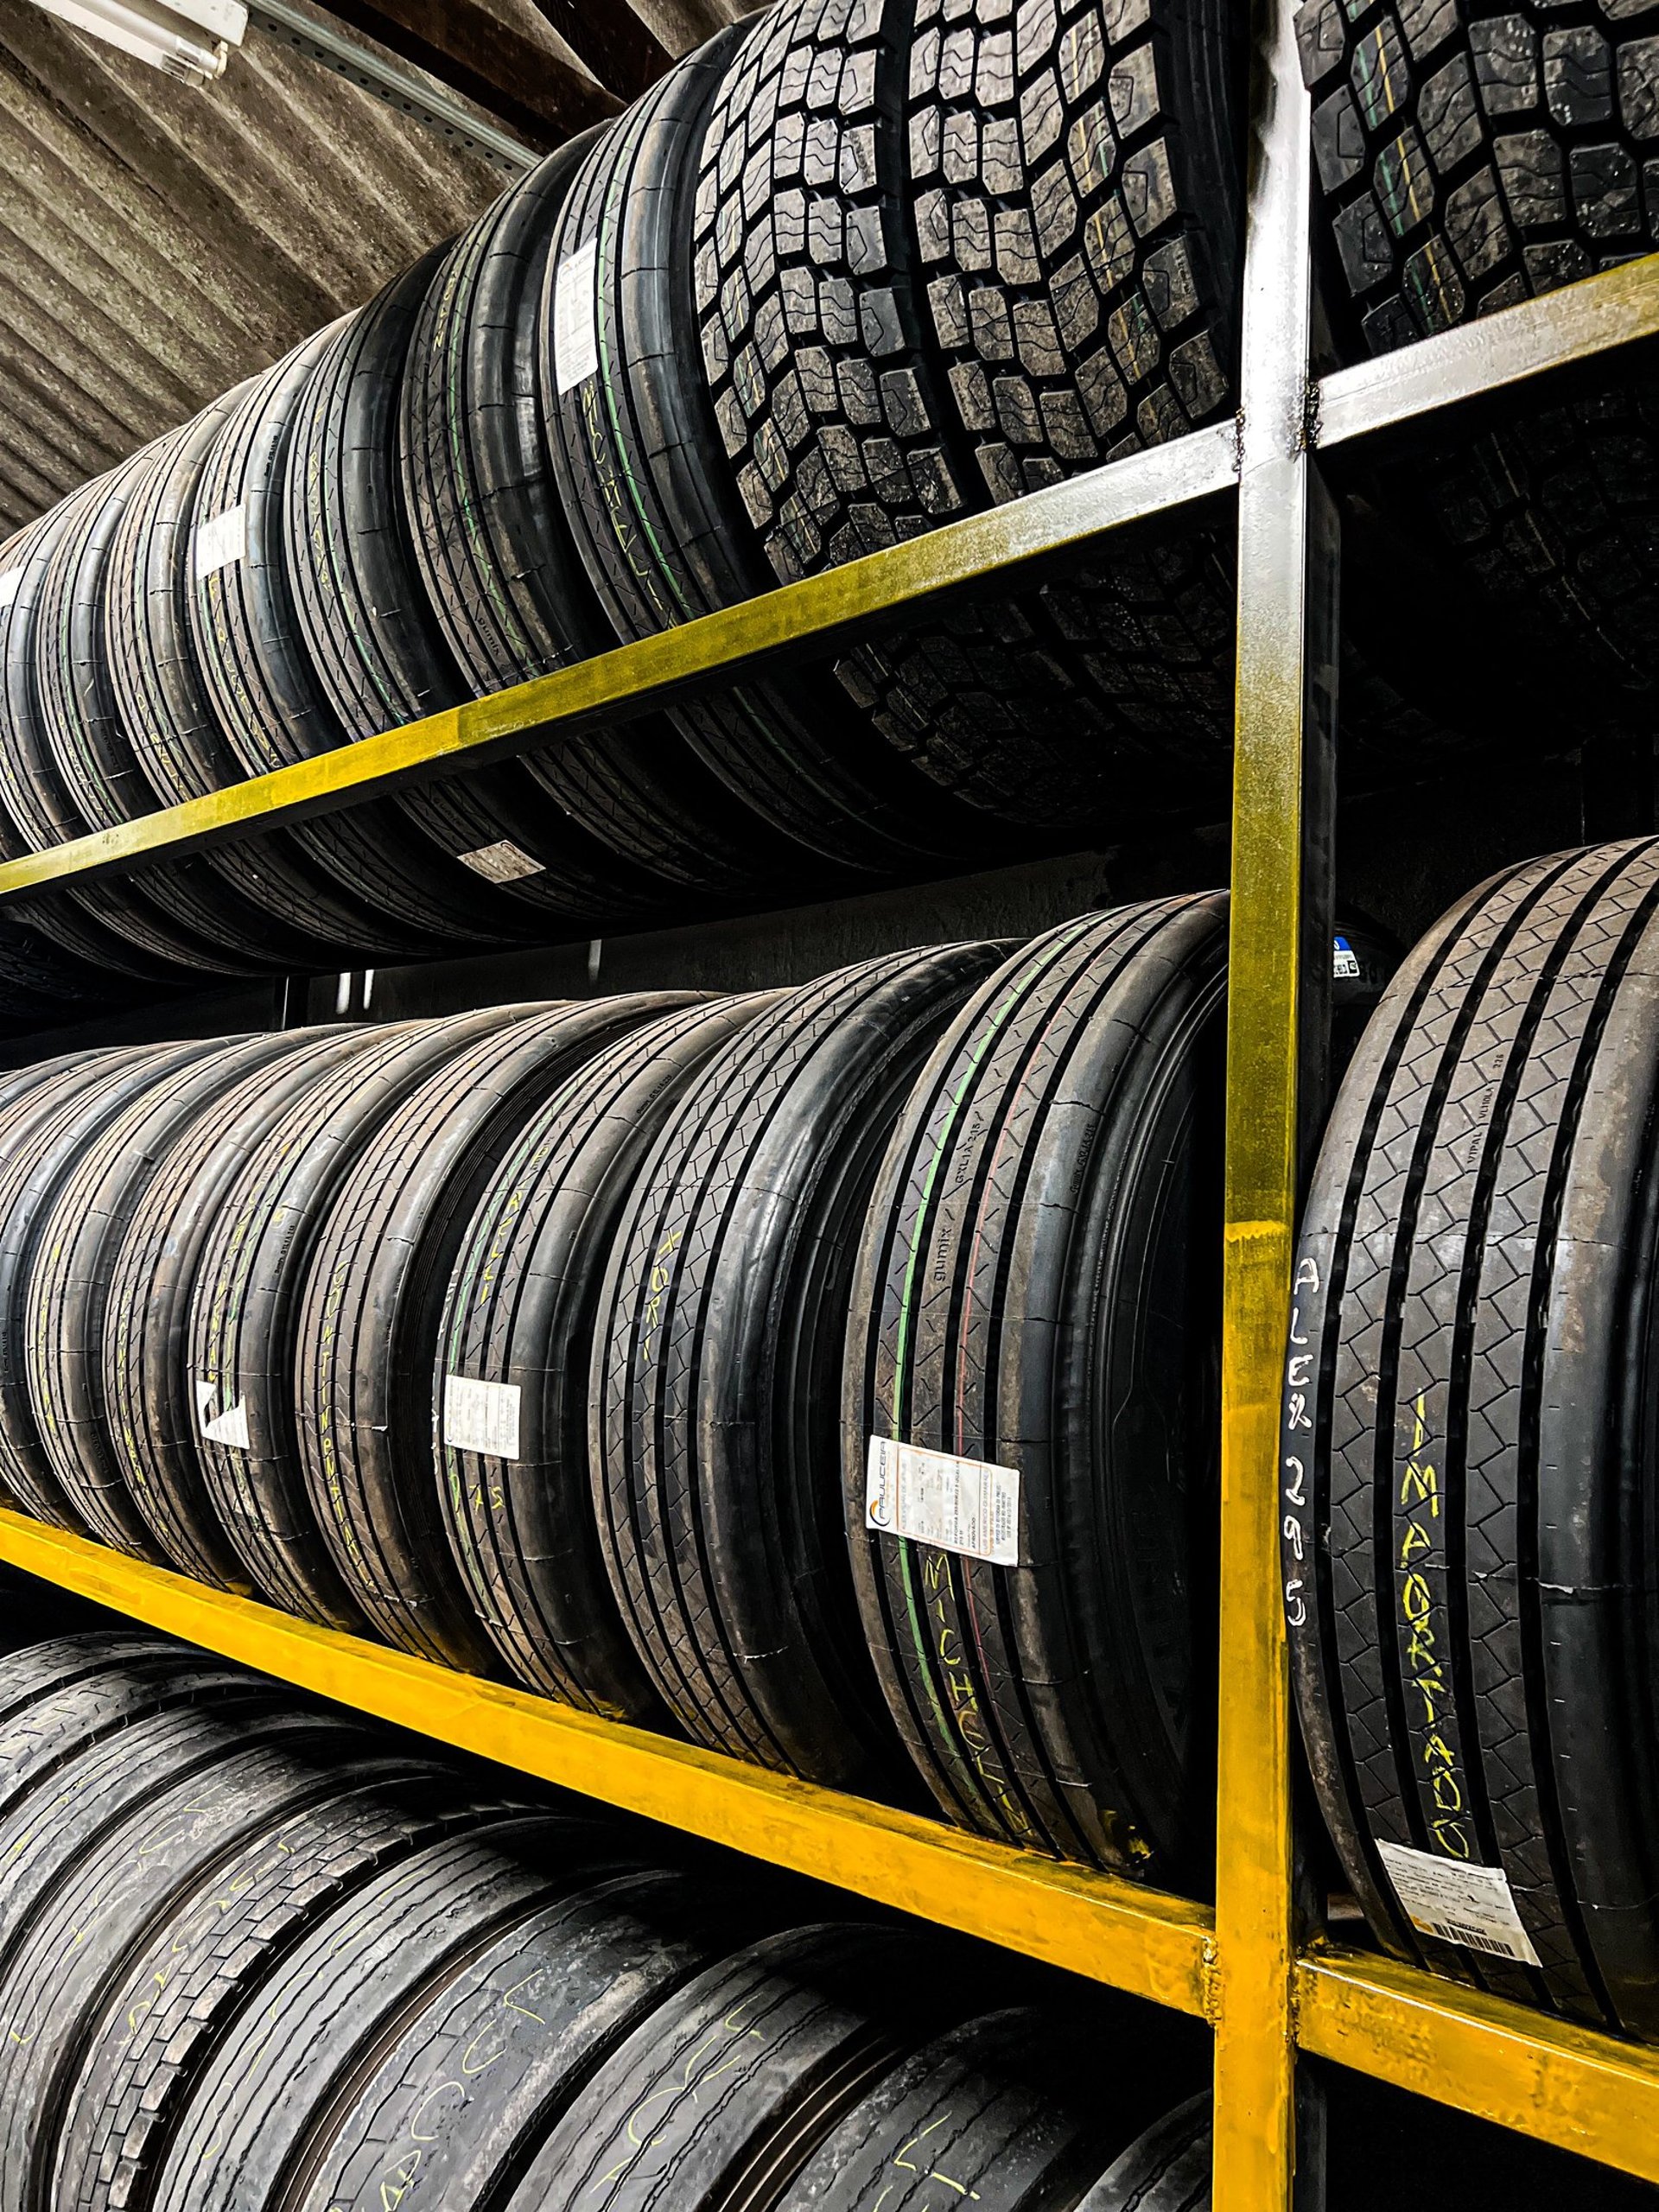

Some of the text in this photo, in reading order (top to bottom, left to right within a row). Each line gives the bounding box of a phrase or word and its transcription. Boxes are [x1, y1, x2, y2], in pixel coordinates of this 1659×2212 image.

[1467, 1132, 1483, 1164] VIPAL
[935, 1228, 954, 1282] gumix
[1283, 1257, 1320, 1628] ALEX 295
[1400, 1387, 1470, 1859] IMPORTADO
